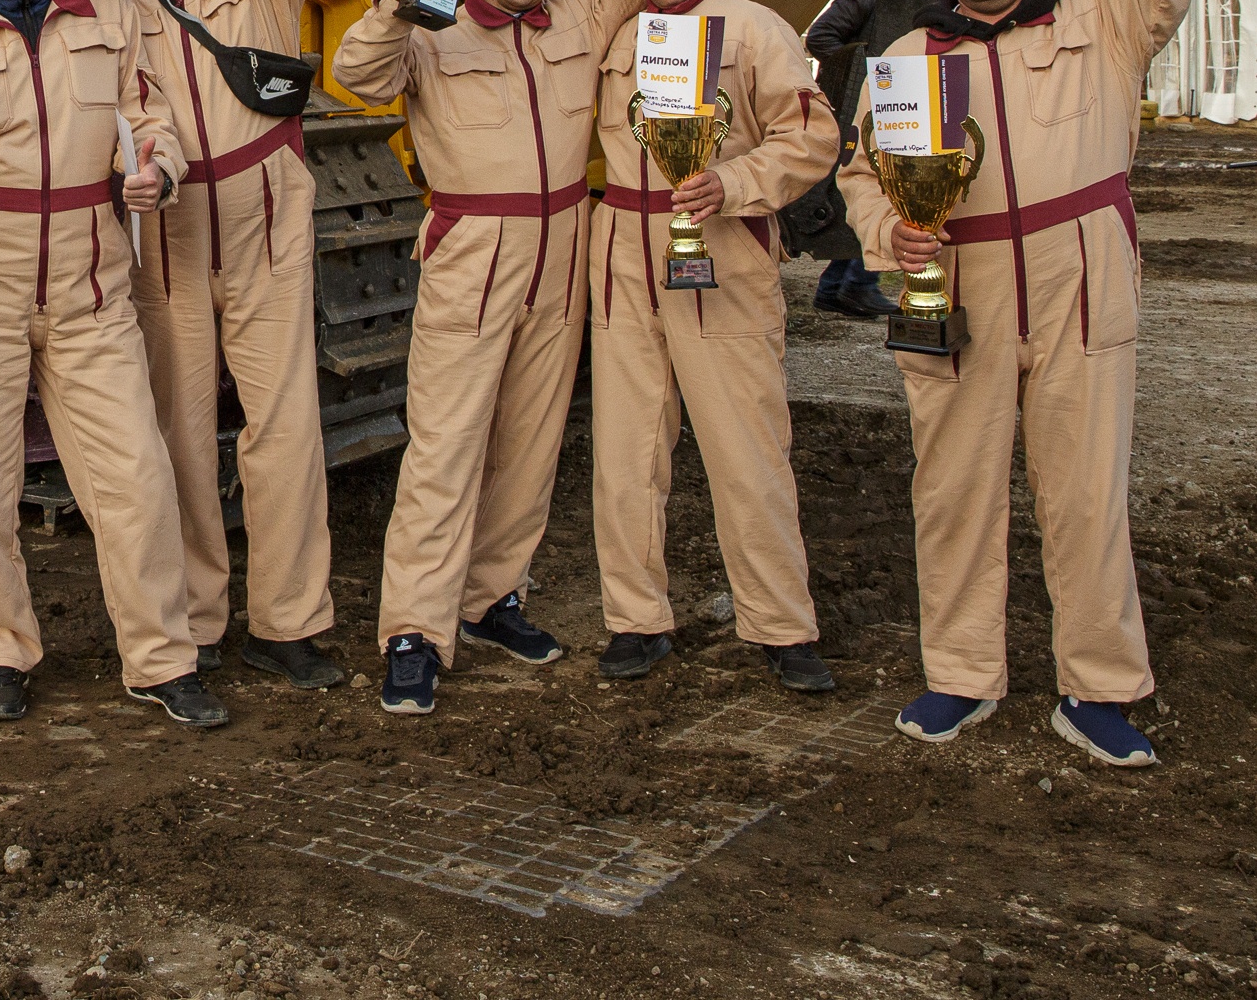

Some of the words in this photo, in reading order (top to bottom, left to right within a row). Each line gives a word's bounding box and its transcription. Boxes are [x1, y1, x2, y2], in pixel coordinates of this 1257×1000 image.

[641, 55, 689, 66] ДИПЛОМ
[640, 69, 648, 79] 3
[651, 74, 688, 83] место
[267, 77, 293, 92] NIKE
[875, 103, 918, 114] ДИПЛОМ
[877, 121, 883, 131] 2
[884, 122, 919, 131] место
